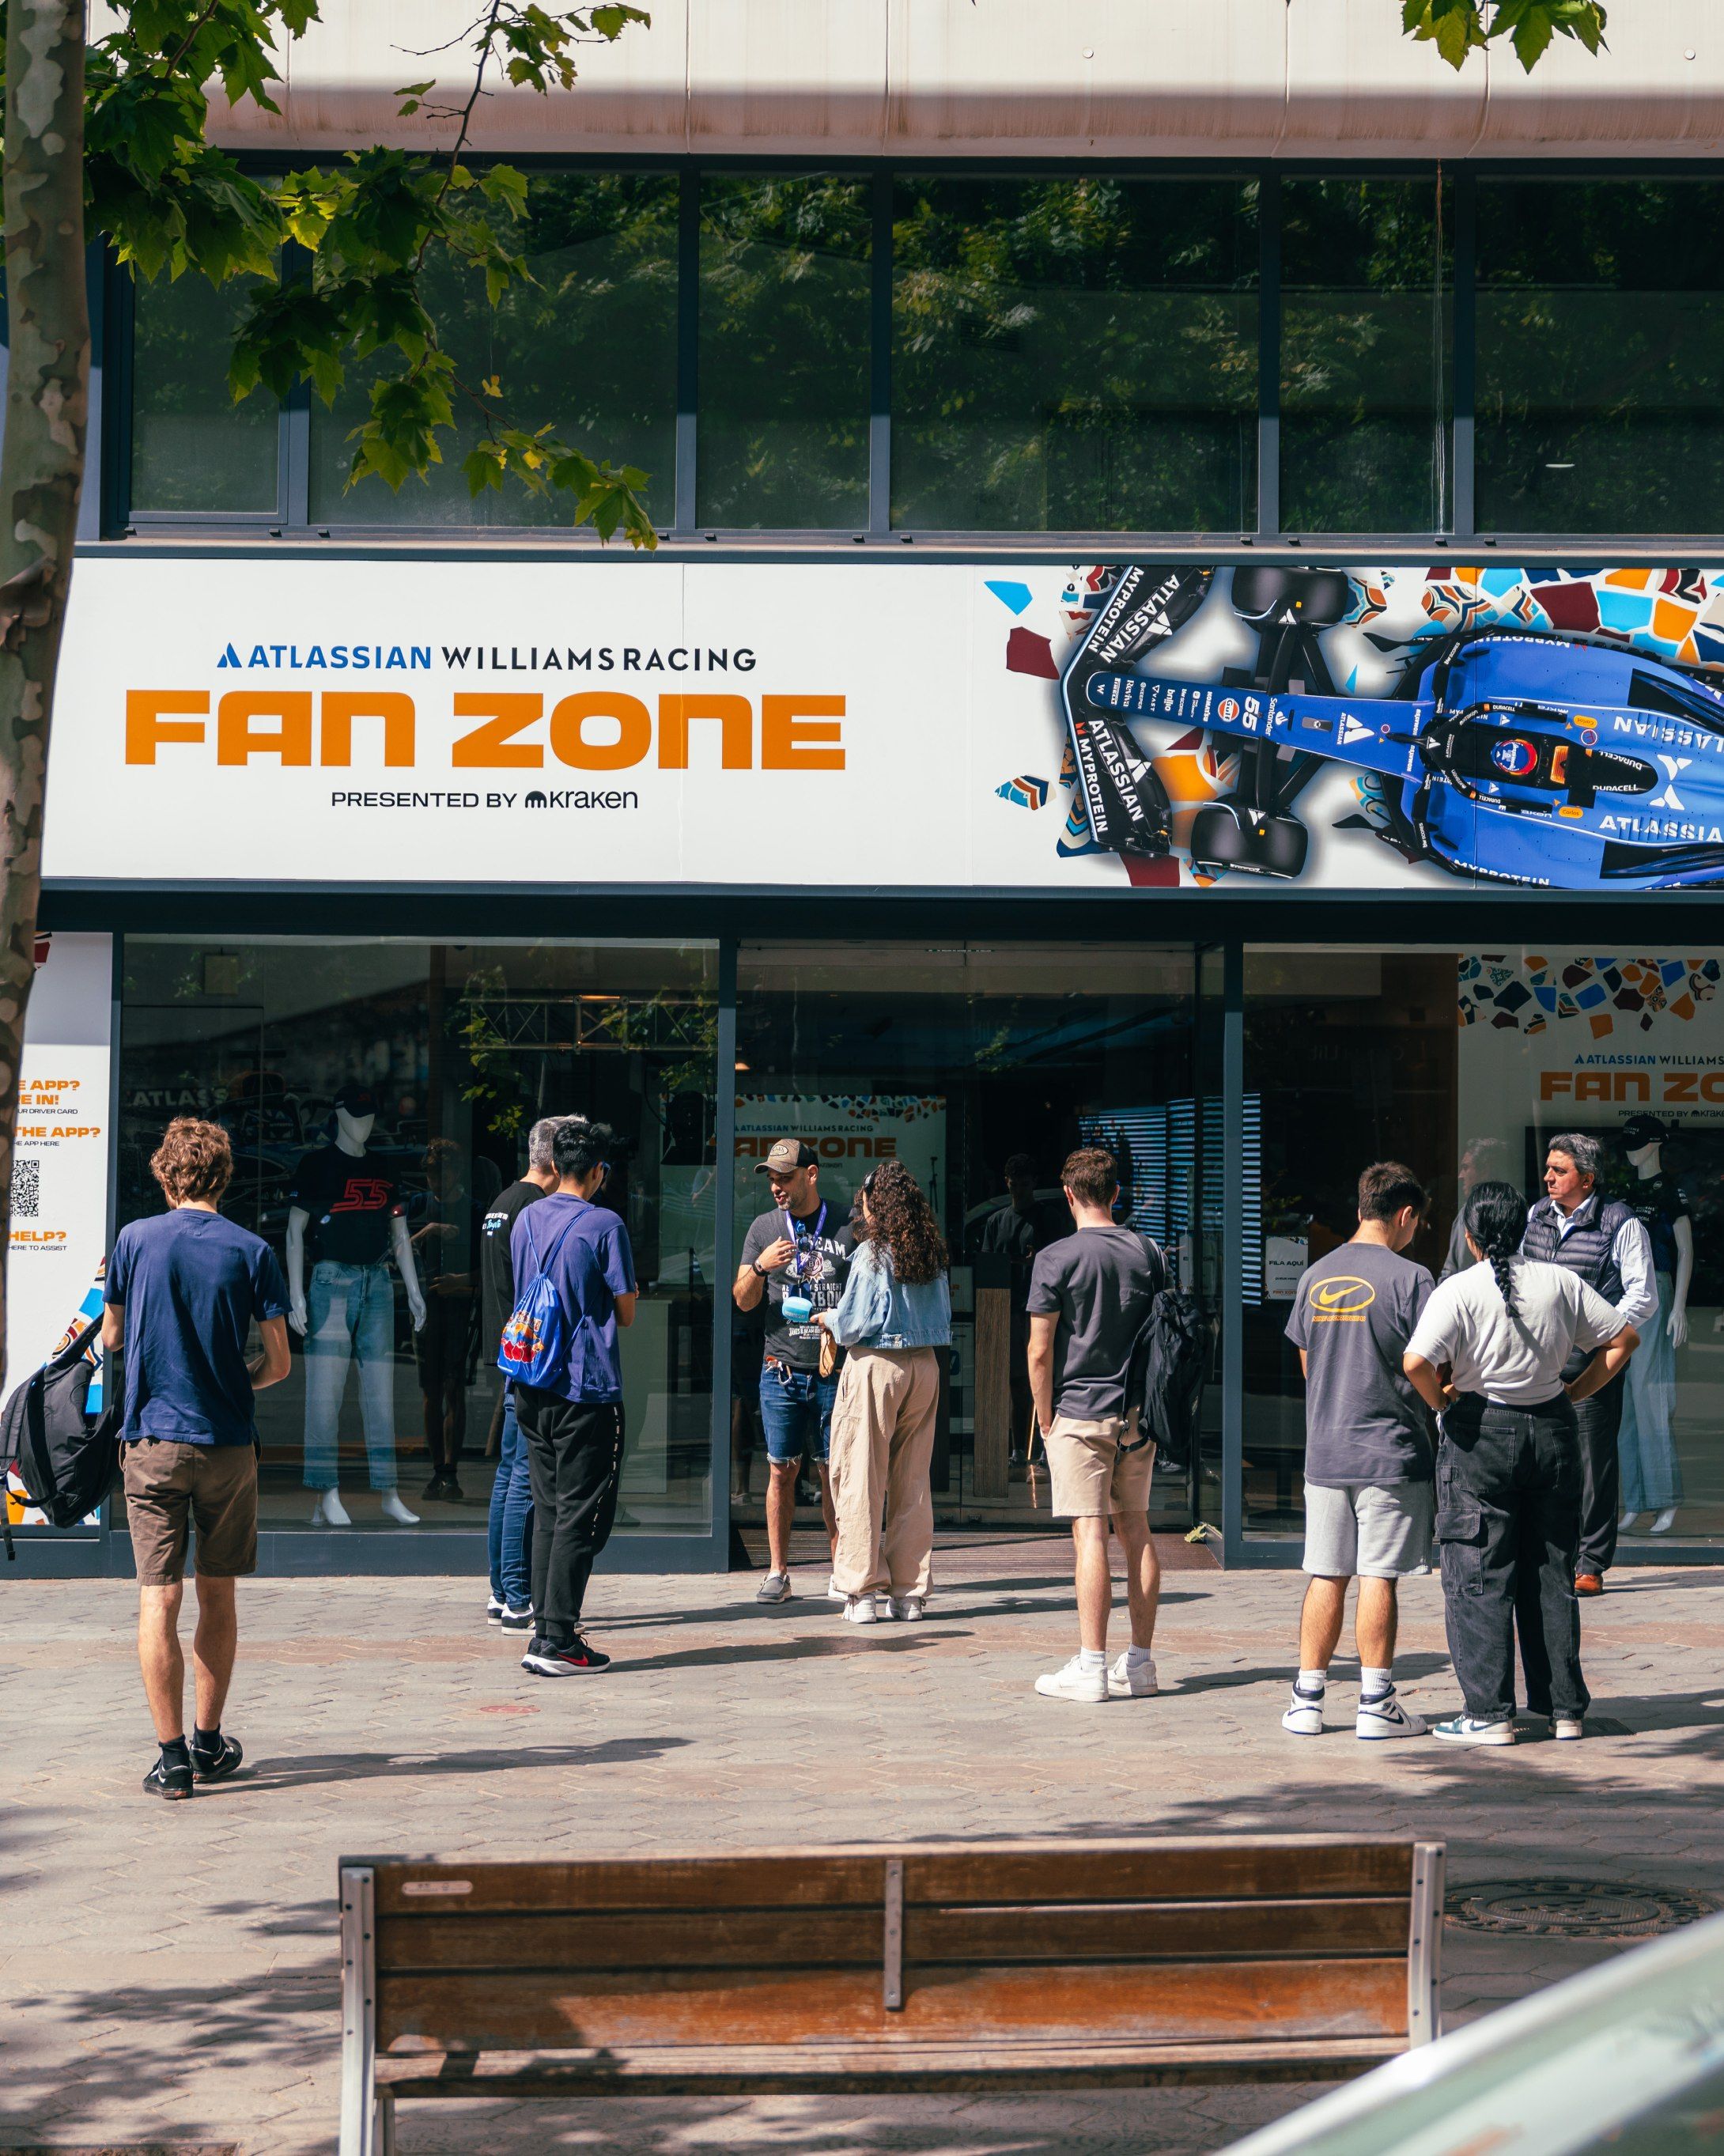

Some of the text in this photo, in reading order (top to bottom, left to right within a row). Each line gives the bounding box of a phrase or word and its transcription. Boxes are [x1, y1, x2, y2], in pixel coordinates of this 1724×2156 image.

[1088, 567, 1144, 653] MYPROTEIN
[1099, 574, 1181, 664] ATLASSIAN
[248, 645, 757, 671] ATLASSIAN WILLIAMS RACING
[1123, 679, 1135, 708] Reviva
[1202, 690, 1213, 722] KOMATSU
[1223, 699, 1233, 721] Gulf
[1242, 696, 1261, 732] 55
[1265, 697, 1278, 737] Santander
[1412, 709, 1422, 736] KOMATSU
[1492, 704, 1516, 713] DURACELL
[125, 689, 846, 771] FAN ZONE
[1336, 712, 1347, 745] ATLASSIAN
[1087, 720, 1145, 822] ATLASSIAN
[1406, 744, 1416, 772] KOMATSU
[1598, 751, 1643, 771] DURACELL
[1079, 738, 1109, 832] MYPROTEIN
[331, 790, 639, 809] PRESENTED BY kraken
[1586, 1054, 1724, 1065] ATLASSIAN WILLIAMS
[30, 1080, 81, 1091] APP?
[36, 1094, 59, 1105] IN!
[1540, 1071, 1651, 1102] FAN
[51, 1127, 101, 1137] APP?
[329, 1178, 394, 1212] 55
[9, 1231, 67, 1242] HELP?
